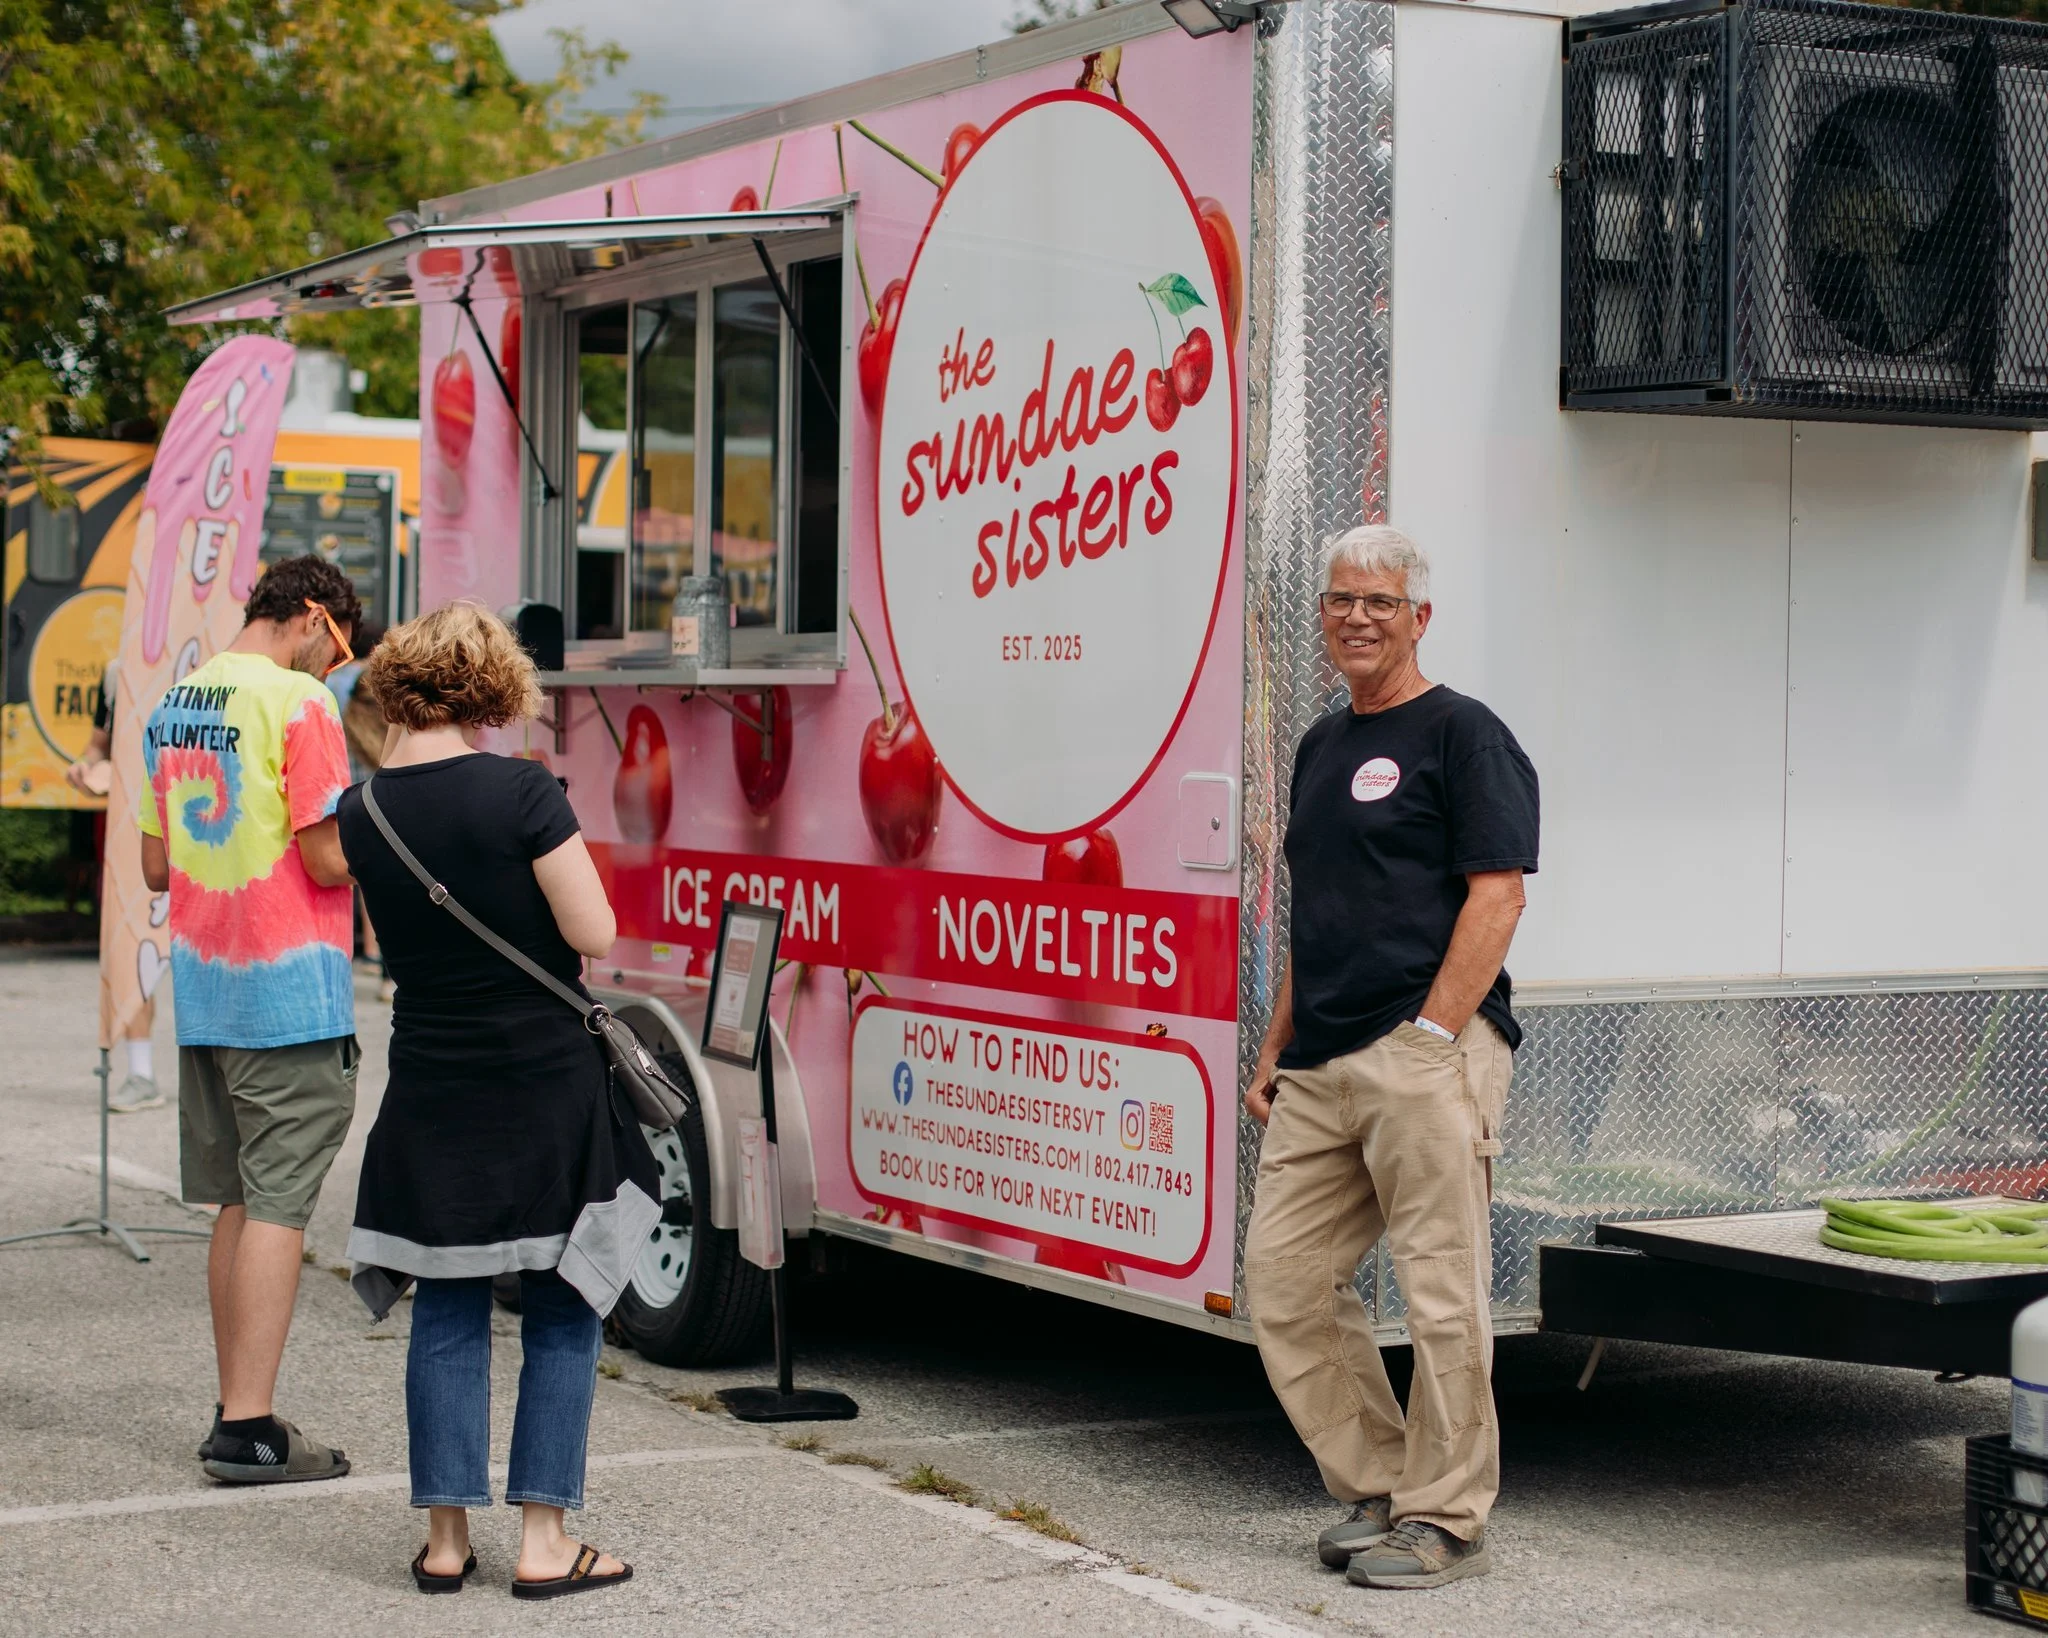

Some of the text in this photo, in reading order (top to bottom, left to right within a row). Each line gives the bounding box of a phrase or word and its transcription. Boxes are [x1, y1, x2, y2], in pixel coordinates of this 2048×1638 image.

[939, 327, 996, 403] the
[902, 338, 1138, 516] sundae
[191, 376, 248, 586] ICE
[972, 450, 1180, 599] sisters
[1002, 635, 1082, 661] EST. 2025
[663, 865, 712, 929] ICE
[939, 895, 1177, 988] NOVELTIES
[904, 1020, 1119, 1091] HOW TO FIND US:
[861, 1107, 1081, 1174] WWW.THESUNDAESISTERS.COM
[1095, 1155, 1192, 1196] 802.417.7843
[927, 1080, 1105, 1136] THESUNDAESISTERSVT
[880, 1150, 1156, 1237] BOOK US FOR YOUR NEXT EVENT!
